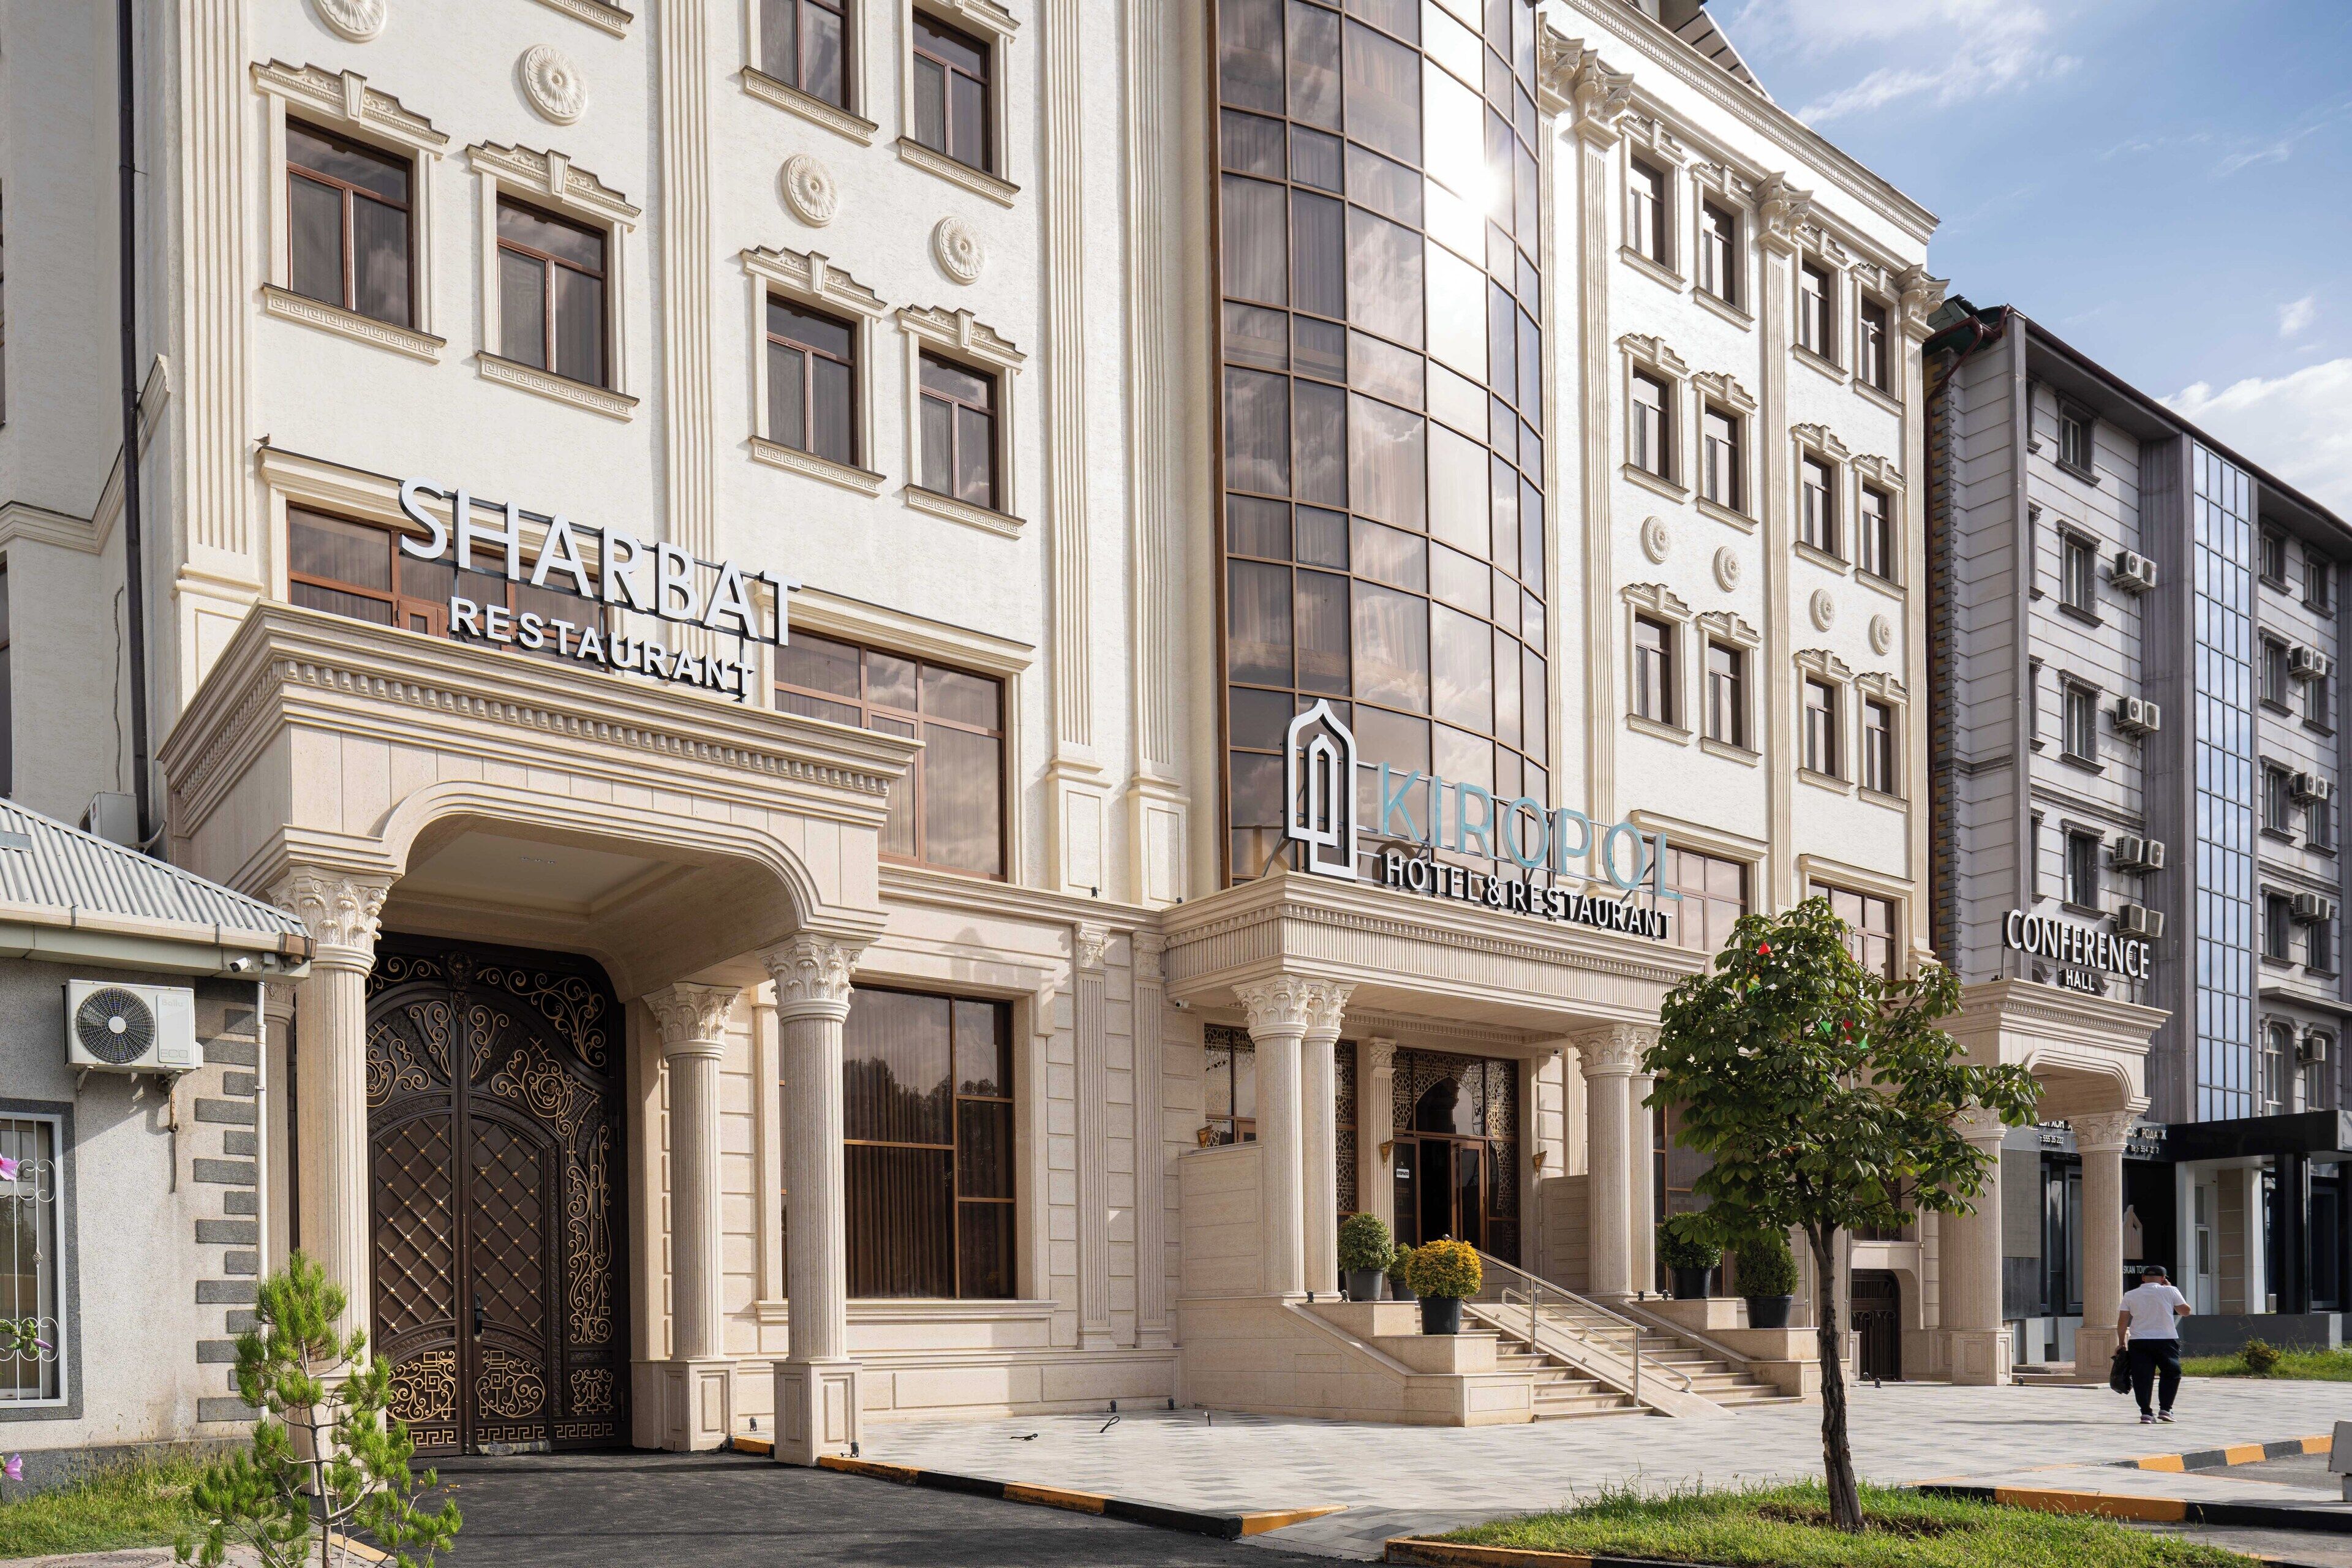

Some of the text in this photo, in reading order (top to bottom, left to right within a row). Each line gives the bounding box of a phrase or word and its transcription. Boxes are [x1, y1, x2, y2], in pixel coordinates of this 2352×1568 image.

[398, 476, 802, 648] SHARBAT
[449, 597, 755, 698] RESTAURANT
[1378, 761, 1683, 901] KIROPOL
[1382, 853, 1674, 940] HOTEL & RESTAURANT
[2003, 909, 2149, 980] CONFERENCE
[2062, 968, 2095, 992] HALL
[162, 998, 184, 1007] Ballu
[160, 1049, 188, 1058] ECO
[2123, 1265, 2136, 1274] SKAN
